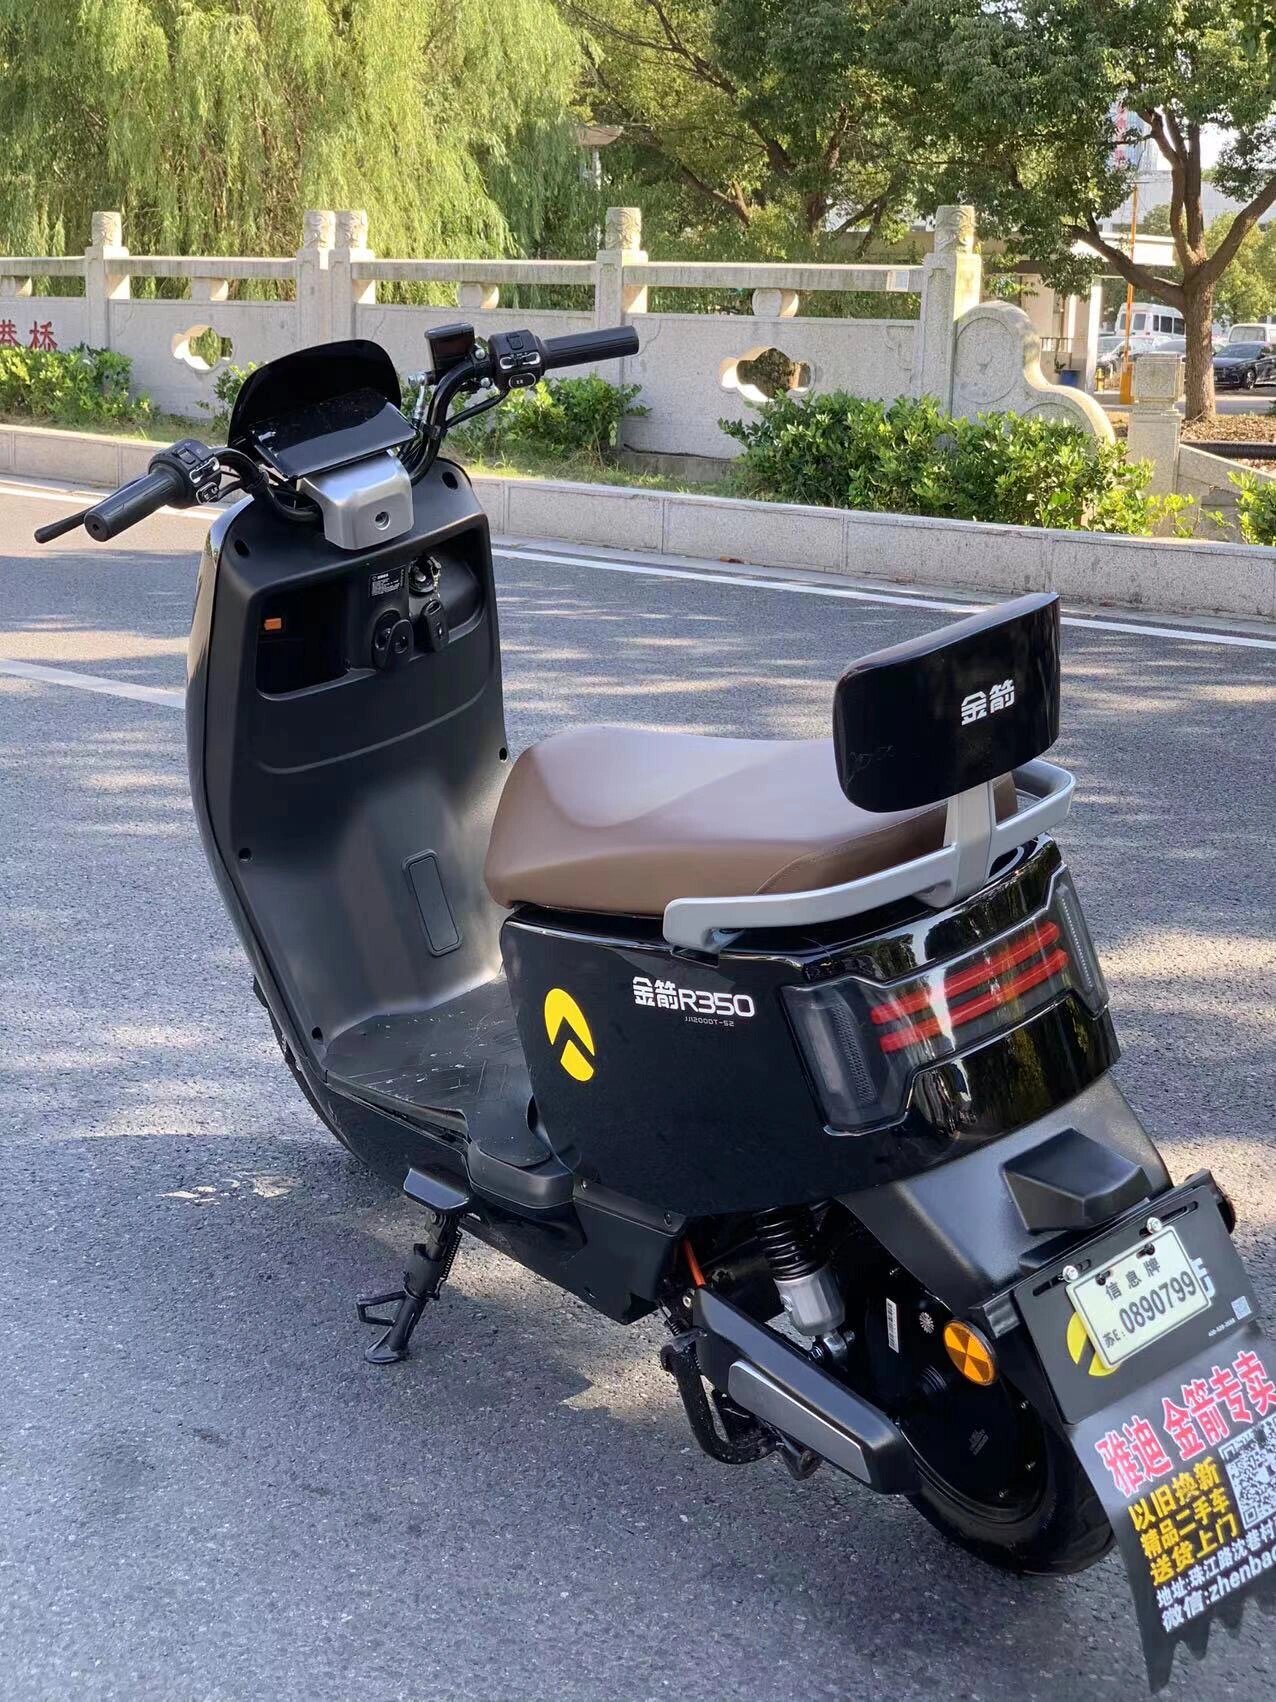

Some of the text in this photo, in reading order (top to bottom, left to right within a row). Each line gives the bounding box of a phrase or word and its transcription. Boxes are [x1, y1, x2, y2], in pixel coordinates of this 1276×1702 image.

[961, 679, 1014, 726] 金箭
[632, 976, 755, 1018] 金箭R350
[1105, 1257, 1161, 1301] 信息牌
[1119, 1270, 1197, 1334] 0890799
[1094, 1350, 1276, 1498] 雅迪 金箭专卖
[1127, 1456, 1222, 1532] 以旧换新
[1140, 1487, 1230, 1560] 精品二手车
[1149, 1512, 1239, 1586] 送货上门
[1156, 1516, 1276, 1609] 地址:珠江路沈巷村
